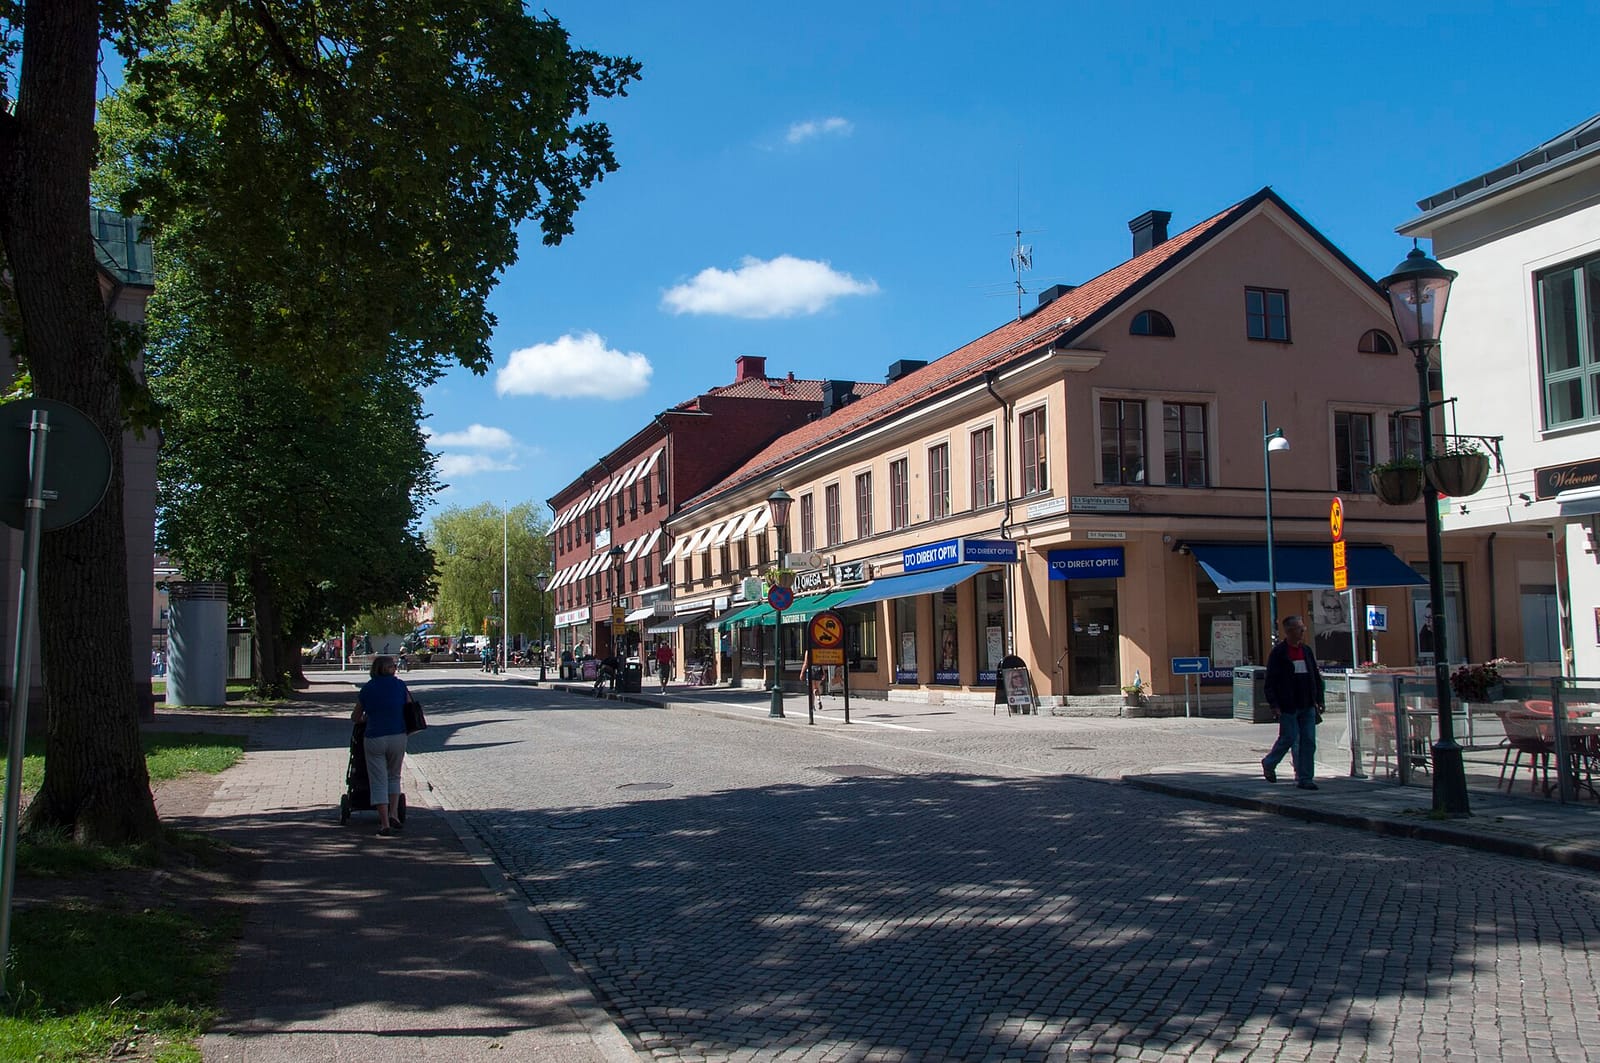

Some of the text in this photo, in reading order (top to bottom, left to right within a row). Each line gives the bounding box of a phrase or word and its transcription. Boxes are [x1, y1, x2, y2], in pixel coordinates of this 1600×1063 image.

[1549, 467, 1598, 488] Welcome
[916, 549, 937, 564] DIREKT
[937, 544, 958, 560] OPTIK
[1067, 560, 1095, 568] DIREKT
[1095, 558, 1119, 567] OPTIK
[801, 573, 822, 589] OMEGA
